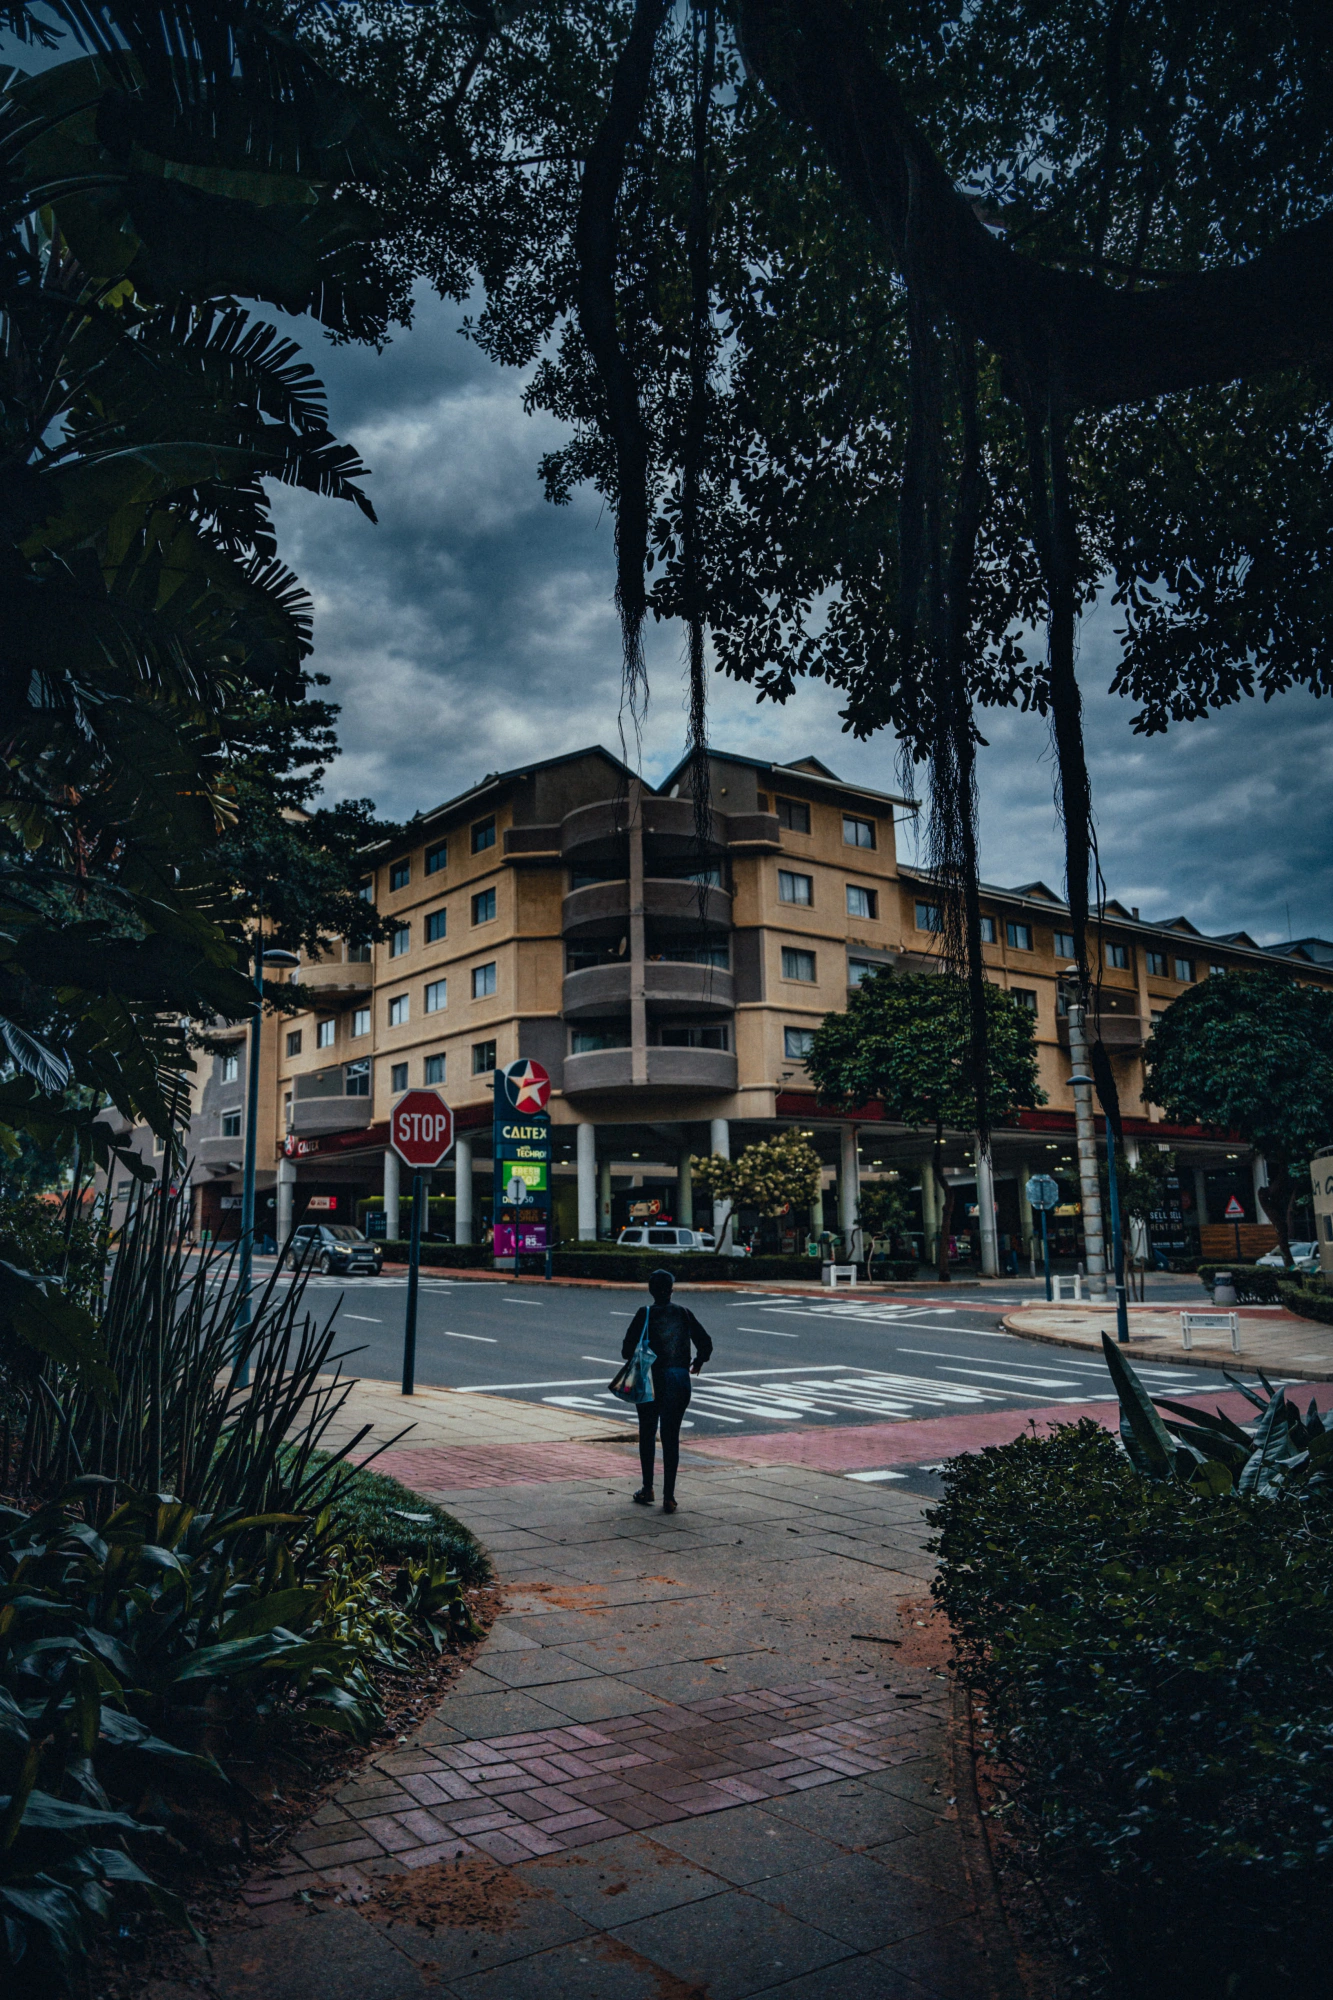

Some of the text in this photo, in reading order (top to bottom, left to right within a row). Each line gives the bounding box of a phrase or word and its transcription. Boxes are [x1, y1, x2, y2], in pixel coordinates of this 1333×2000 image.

[399, 1113, 446, 1142] STOP
[502, 1126, 547, 1139] CALTEX
[1149, 1211, 1167, 1219] SELL
[1169, 1211, 1181, 1219] SELL
[1150, 1223, 1168, 1231] RENT
